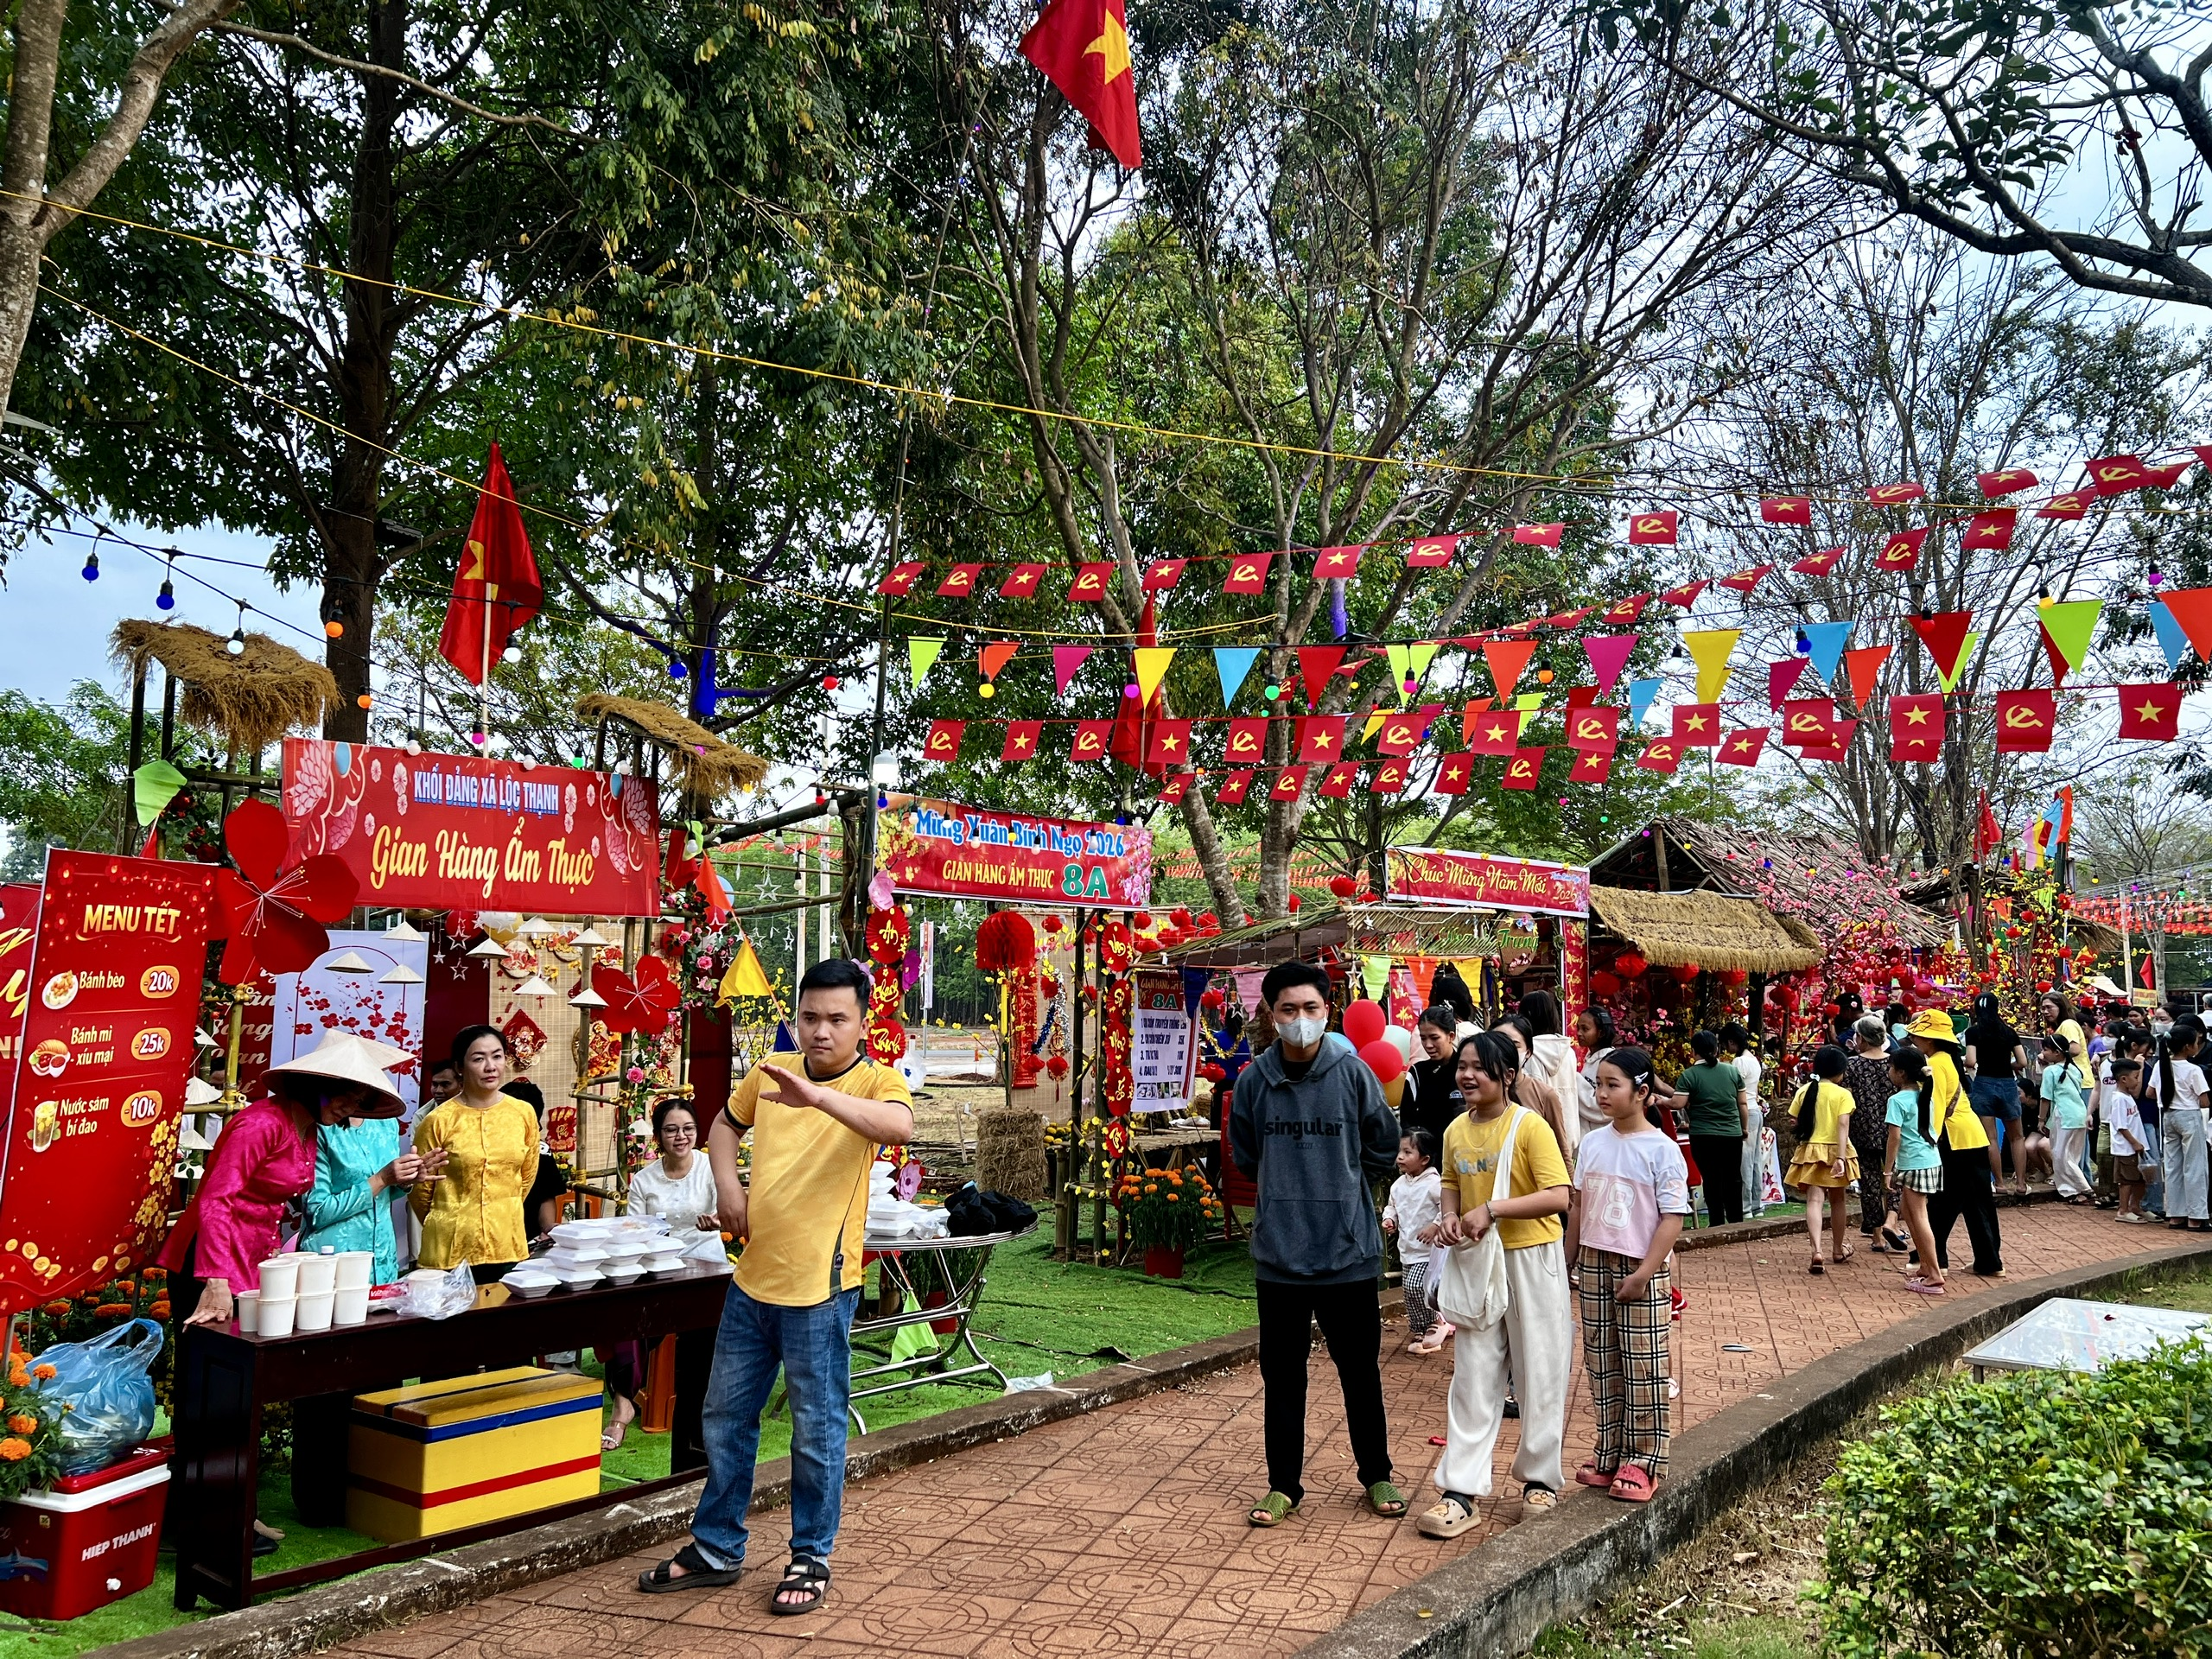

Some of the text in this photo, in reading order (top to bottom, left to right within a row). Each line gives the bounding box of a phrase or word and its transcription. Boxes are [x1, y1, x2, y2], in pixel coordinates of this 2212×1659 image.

[415, 763, 559, 819] KHỐI ĐẢNG XÃ LỘC THẠNH
[1050, 824, 1083, 858] Ngọ
[371, 817, 594, 899] Gian Hàng Ẩm Thực
[943, 860, 971, 881] GIAN
[975, 861, 1007, 885] HÀNG
[1027, 868, 1055, 889] THỰC
[1061, 864, 1111, 899] 8A
[1408, 855, 1444, 884] Chúc
[1445, 860, 1486, 899] Mừng
[1486, 864, 1518, 891] Năm
[1518, 868, 1547, 895] Mới
[83, 901, 181, 935] MENU TẾT
[79, 970, 105, 989] Bánh
[106, 970, 125, 988] bèo
[1152, 993, 1179, 1009] 8A
[71, 1026, 97, 1045] Bánh
[76, 1046, 92, 1065] xíu
[94, 1046, 114, 1066] mại
[60, 1097, 86, 1116] Nước
[66, 1118, 78, 1137] bí
[78, 1117, 98, 1135] đao
[1264, 1116, 1343, 1141] singular
[1586, 1176, 1636, 1230] 78
